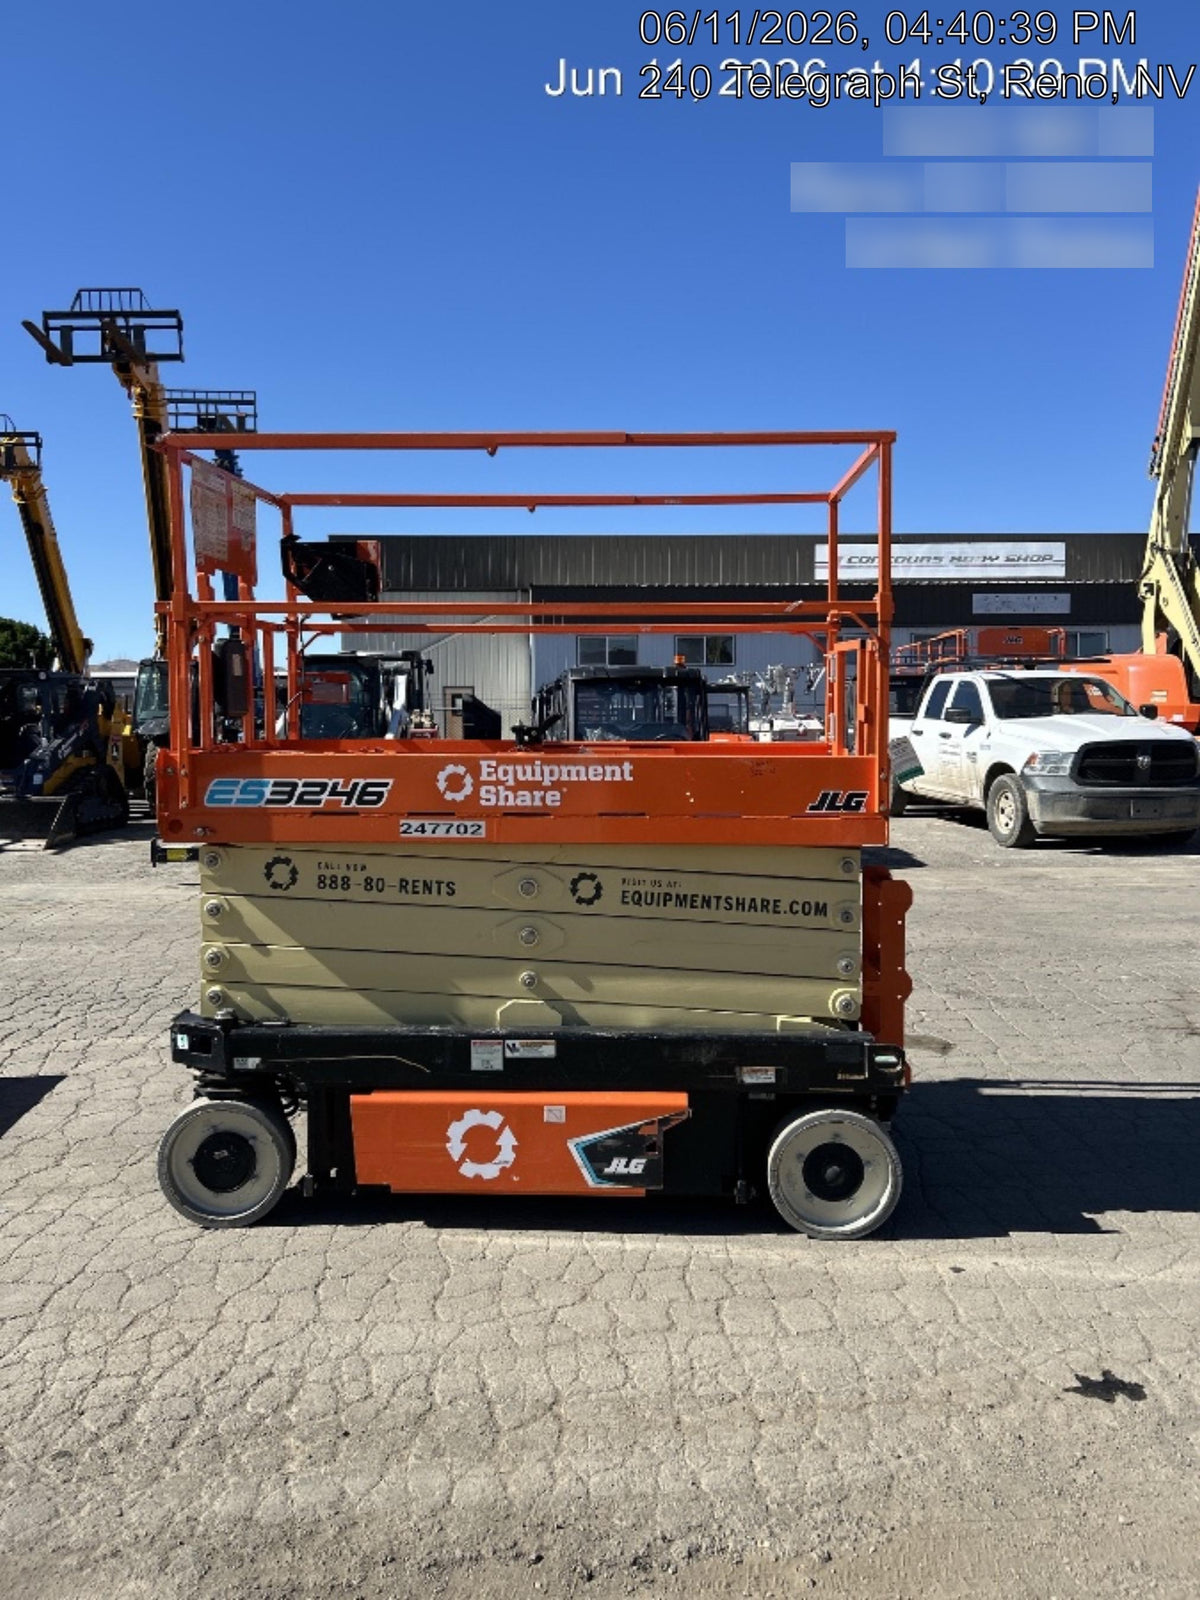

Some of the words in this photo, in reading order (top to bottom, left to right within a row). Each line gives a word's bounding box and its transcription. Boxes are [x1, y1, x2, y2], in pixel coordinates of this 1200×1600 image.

[1005, 553, 1054, 563] SHOP
[479, 760, 634, 786] Equipment
[204, 778, 394, 808] ES3246
[479, 785, 562, 807] Share
[805, 790, 870, 813] JLG
[399, 822, 483, 836] 247702
[317, 874, 457, 897] 888-80-RENTS
[621, 889, 828, 918] EQUIPMENTSHARE.COM
[603, 1157, 648, 1174] JLG
